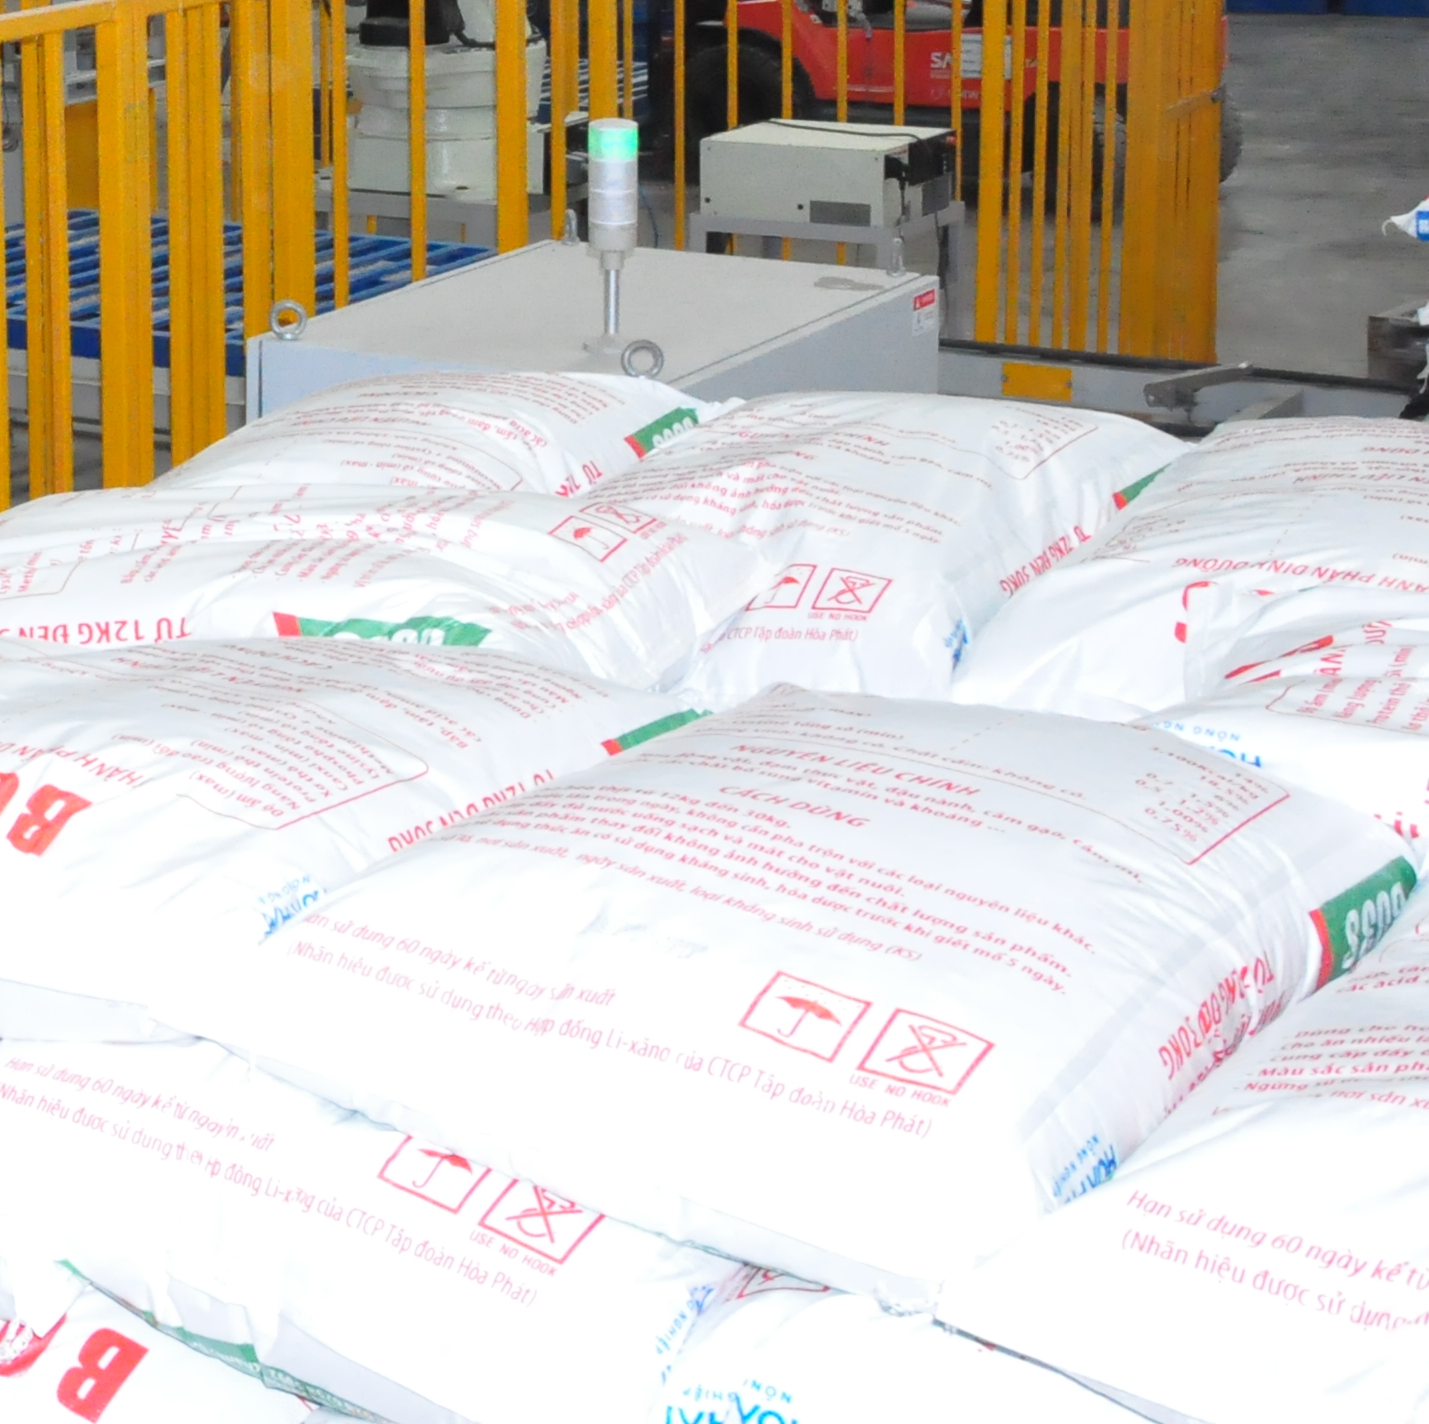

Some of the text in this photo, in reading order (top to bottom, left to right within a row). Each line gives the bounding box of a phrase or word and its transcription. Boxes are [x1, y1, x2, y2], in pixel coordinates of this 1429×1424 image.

[78, 619, 145, 645] 12KG
[774, 627, 858, 642] đoàn Hòa Phát)
[734, 745, 979, 795] NGUYÊN LIỆU CHÍNH
[720, 787, 868, 826] CÁCH DÙNG
[633, 813, 903, 896] uống sạch và mát cho vật nuôi.
[641, 802, 1094, 953] ngày, không cần pha trộn với các loại nguyên liệu khác.
[570, 828, 590, 836] ăn
[615, 837, 633, 845] sử
[635, 842, 675, 860] dụng
[679, 855, 729, 877] kháng
[734, 873, 769, 889] sinh,
[776, 884, 808, 899] hóa
[812, 897, 849, 912] dược
[856, 909, 897, 927] trước
[904, 924, 930, 937] khi
[935, 936, 969, 950] giết
[973, 948, 1006, 961] mổ
[1007, 958, 1018, 967] 5
[1022, 966, 1063, 990] ngày.
[591, 818, 1069, 976] thay đổi không ảnh hưởng đến chất lượng sản phẩm.
[850, 1076, 949, 1106] USE NO HOOK
[1260, 1063, 1388, 1076] Màu sắc sản
[470, 1231, 556, 1276] USE NO HOOK
[1128, 1191, 1412, 1284] Hạn sử dụng 60 ngày kể
[1122, 1230, 1345, 1314] (Nhãn hiệu được sử
